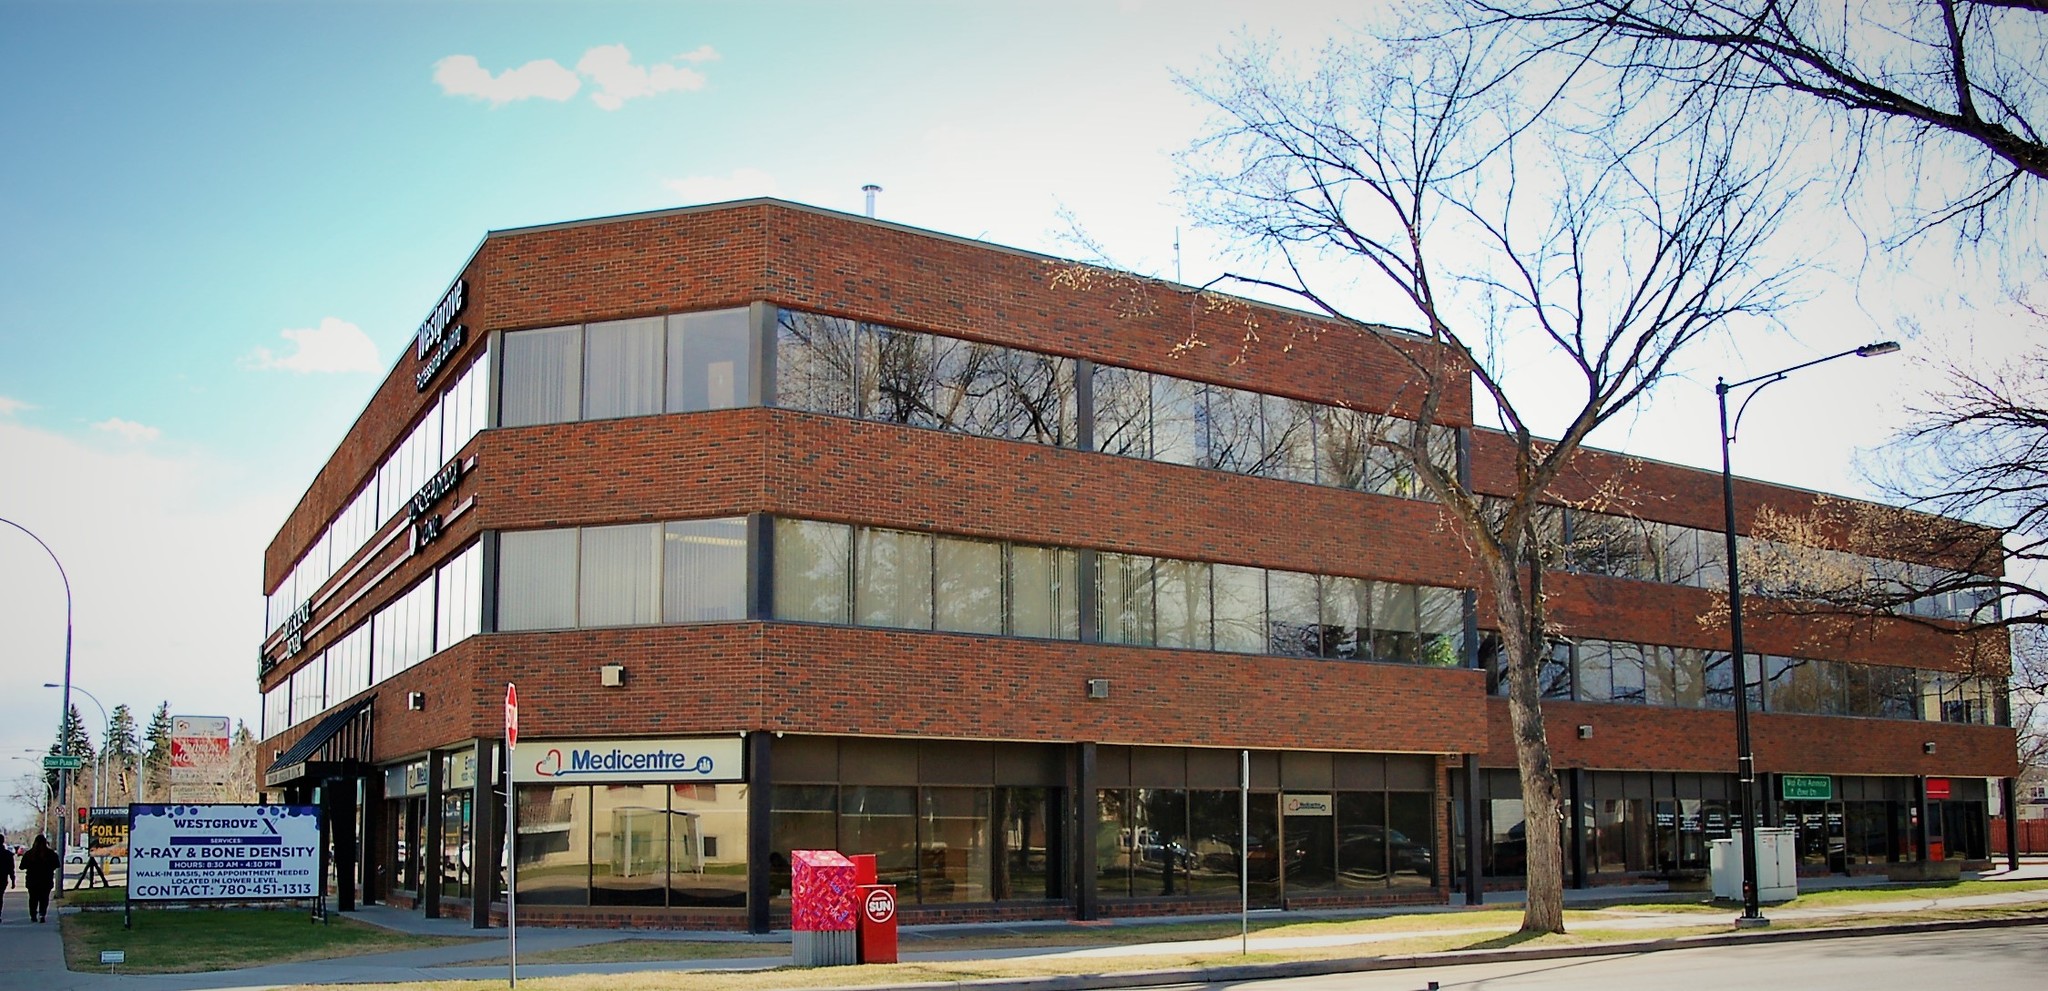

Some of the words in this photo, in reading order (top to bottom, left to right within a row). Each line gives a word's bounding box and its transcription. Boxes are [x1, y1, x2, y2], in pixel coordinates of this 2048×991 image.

[417, 279, 463, 361] Westgrove
[572, 749, 685, 770] Medicentre
[174, 819, 258, 829] WESTGROVE
[91, 825, 113, 837] FOR
[98, 837, 120, 845] OFFICE
[134, 847, 182, 858] X-RAY
[186, 847, 197, 858] &
[201, 847, 245, 858] BONE
[250, 847, 315, 858] DENSITY
[136, 885, 214, 896] CONTACT:
[219, 884, 311, 895] 780-451-1313
[869, 900, 891, 912] SUN
